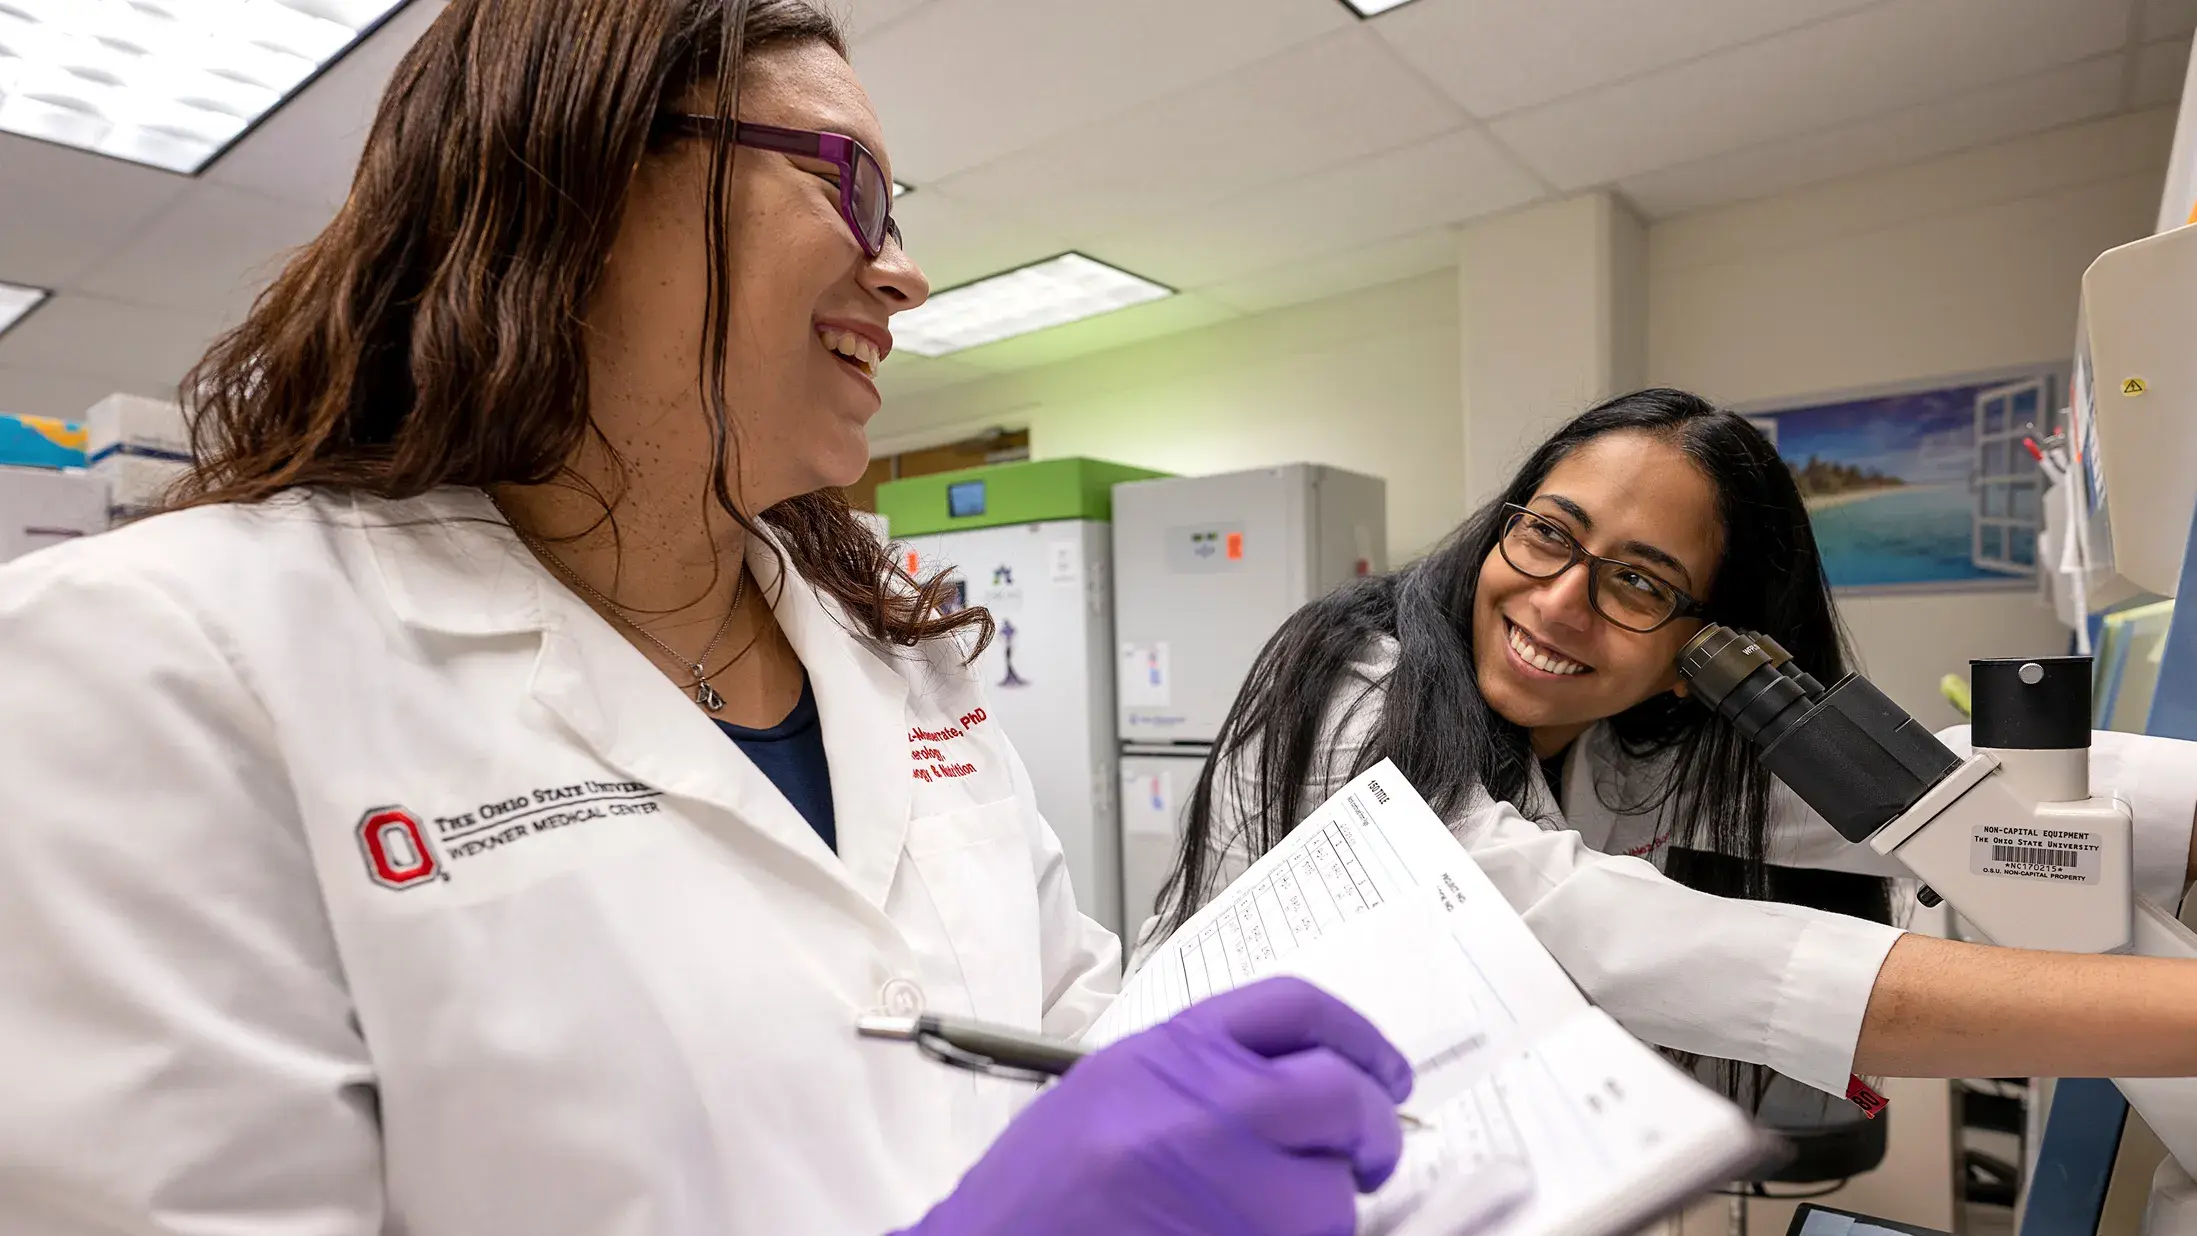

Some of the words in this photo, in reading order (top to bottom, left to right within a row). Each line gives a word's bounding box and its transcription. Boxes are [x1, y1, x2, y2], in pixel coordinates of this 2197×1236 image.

[960, 707, 987, 730] PhD
[480, 797, 529, 819] OHIO
[532, 785, 584, 803] STATE
[1374, 788, 1390, 805] TITLE
[533, 808, 607, 832] MEDICAL
[609, 801, 660, 815] CENTER
[1984, 826, 2038, 837] NON-CAPITAL
[2043, 830, 2090, 840] EQUIPMENT
[1993, 837, 2013, 845] OHIO
[2018, 839, 2043, 847] STATE
[2048, 841, 2100, 851] UNIVERSITY
[2004, 869, 2048, 878] NON-CAPITAL
[2050, 873, 2086, 882] PROPERTY
